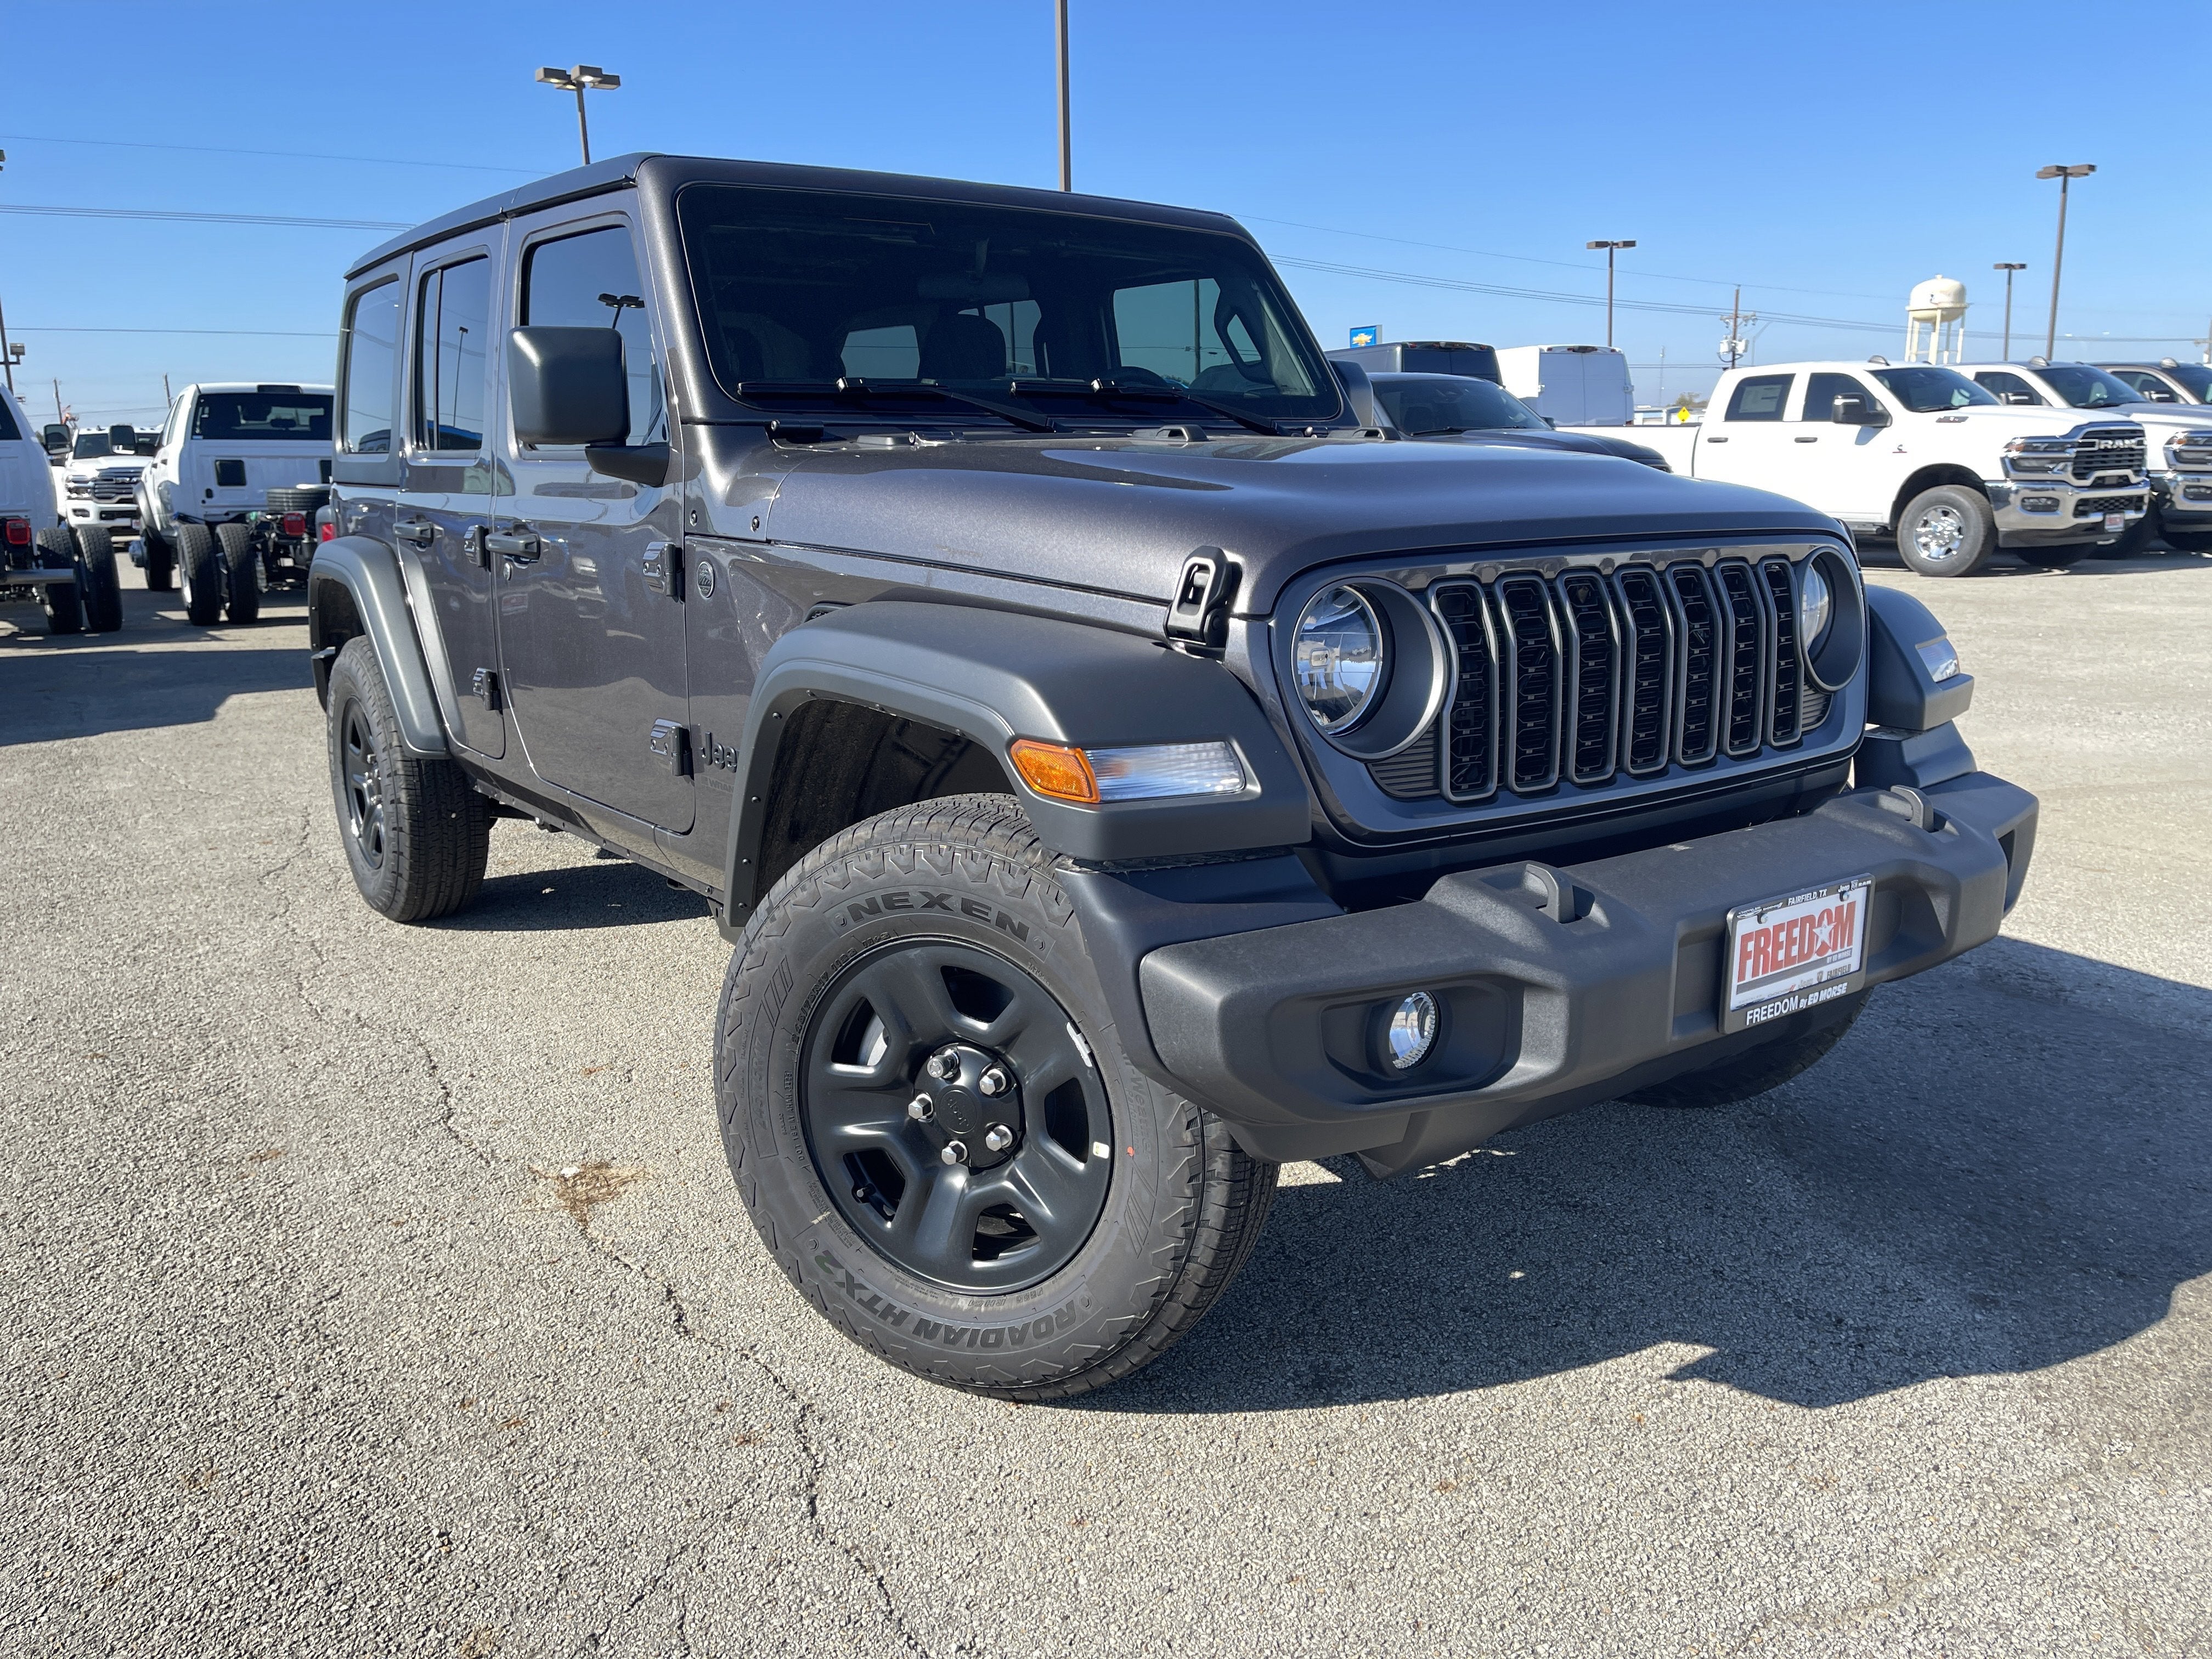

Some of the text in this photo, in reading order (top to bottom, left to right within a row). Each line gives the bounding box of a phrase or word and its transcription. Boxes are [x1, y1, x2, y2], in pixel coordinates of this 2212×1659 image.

[2098, 439, 2136, 449] RAM
[698, 731, 739, 773] Jee
[846, 891, 1030, 943] NEXEN
[1787, 889, 1827, 906] FAIRFIELD, TX
[1737, 901, 1857, 983] FREEDOM
[1746, 996, 1798, 1025] FREEDOM
[1808, 993, 1818, 1005] ED
[1819, 983, 1848, 1002] MORSE
[793, 1143, 805, 1161] DOT
[812, 1249, 911, 1328] HTX2
[911, 1300, 1077, 1349] ROADIAN
